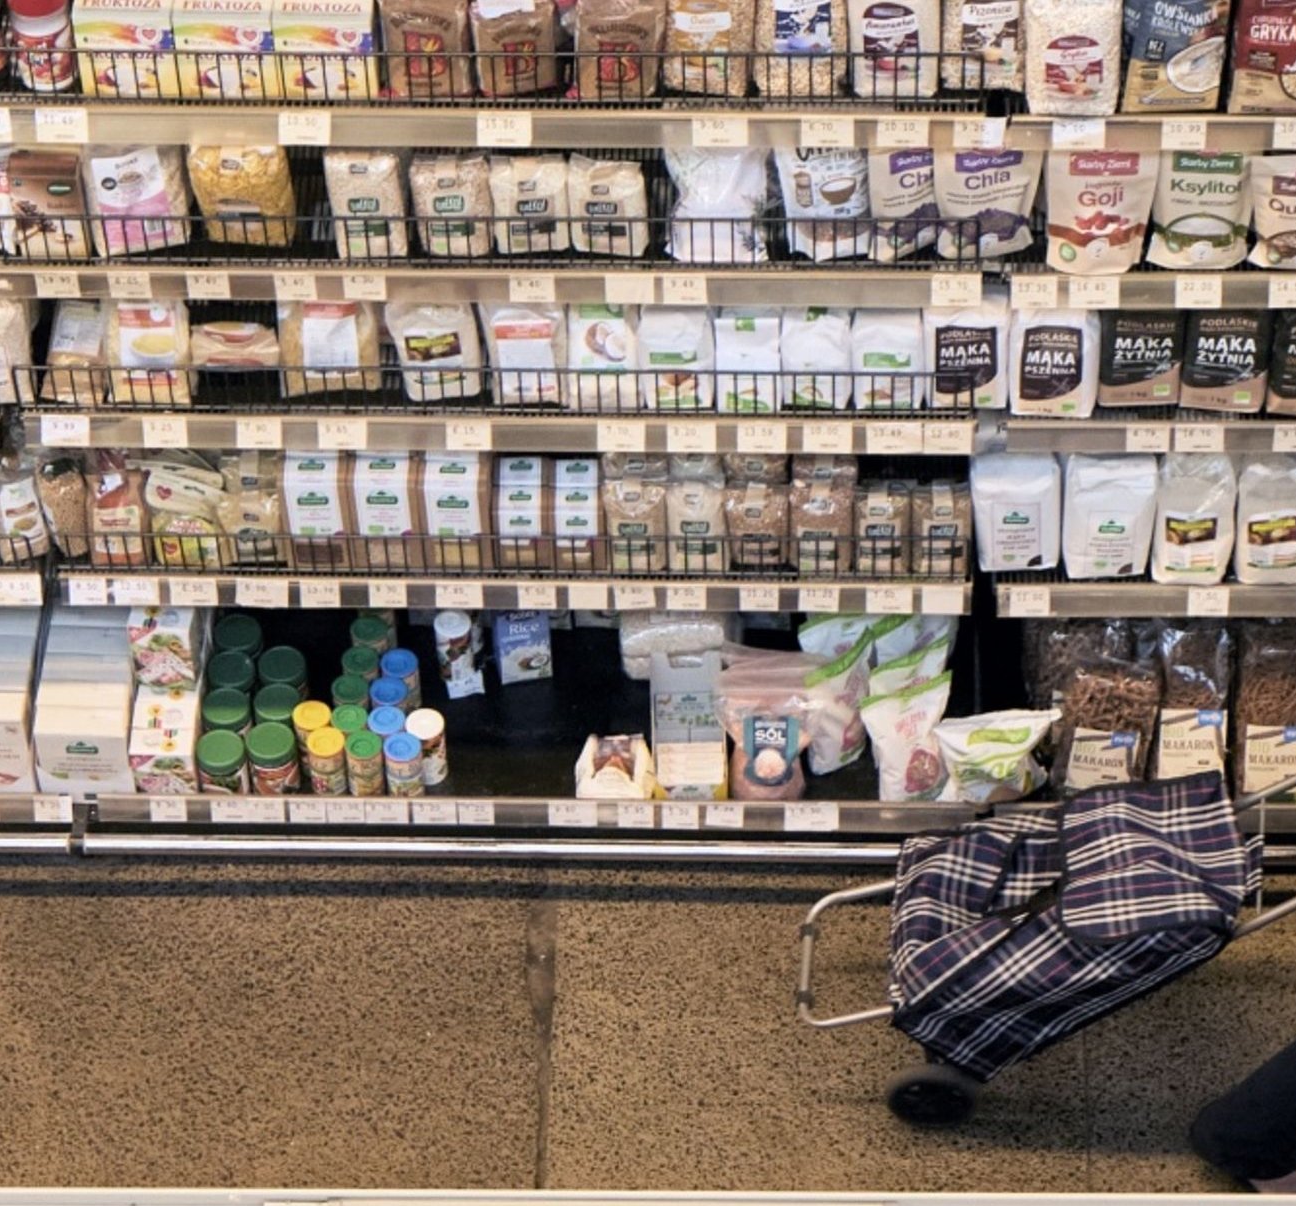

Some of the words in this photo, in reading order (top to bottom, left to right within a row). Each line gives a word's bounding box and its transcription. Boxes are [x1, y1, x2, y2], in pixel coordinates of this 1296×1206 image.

[81, 0, 156, 13] FRUKTOZA
[182, 0, 260, 14] FRUKTOZA
[282, 0, 361, 13] FRUKTOZA
[964, 169, 1012, 191] Chia
[1170, 178, 1242, 197] Ksylitol
[1078, 188, 1126, 209] Goji
[508, 621, 540, 635] Rice
[1161, 737, 1216, 753] MAKARON
[1072, 753, 1125, 771] MAKARON
